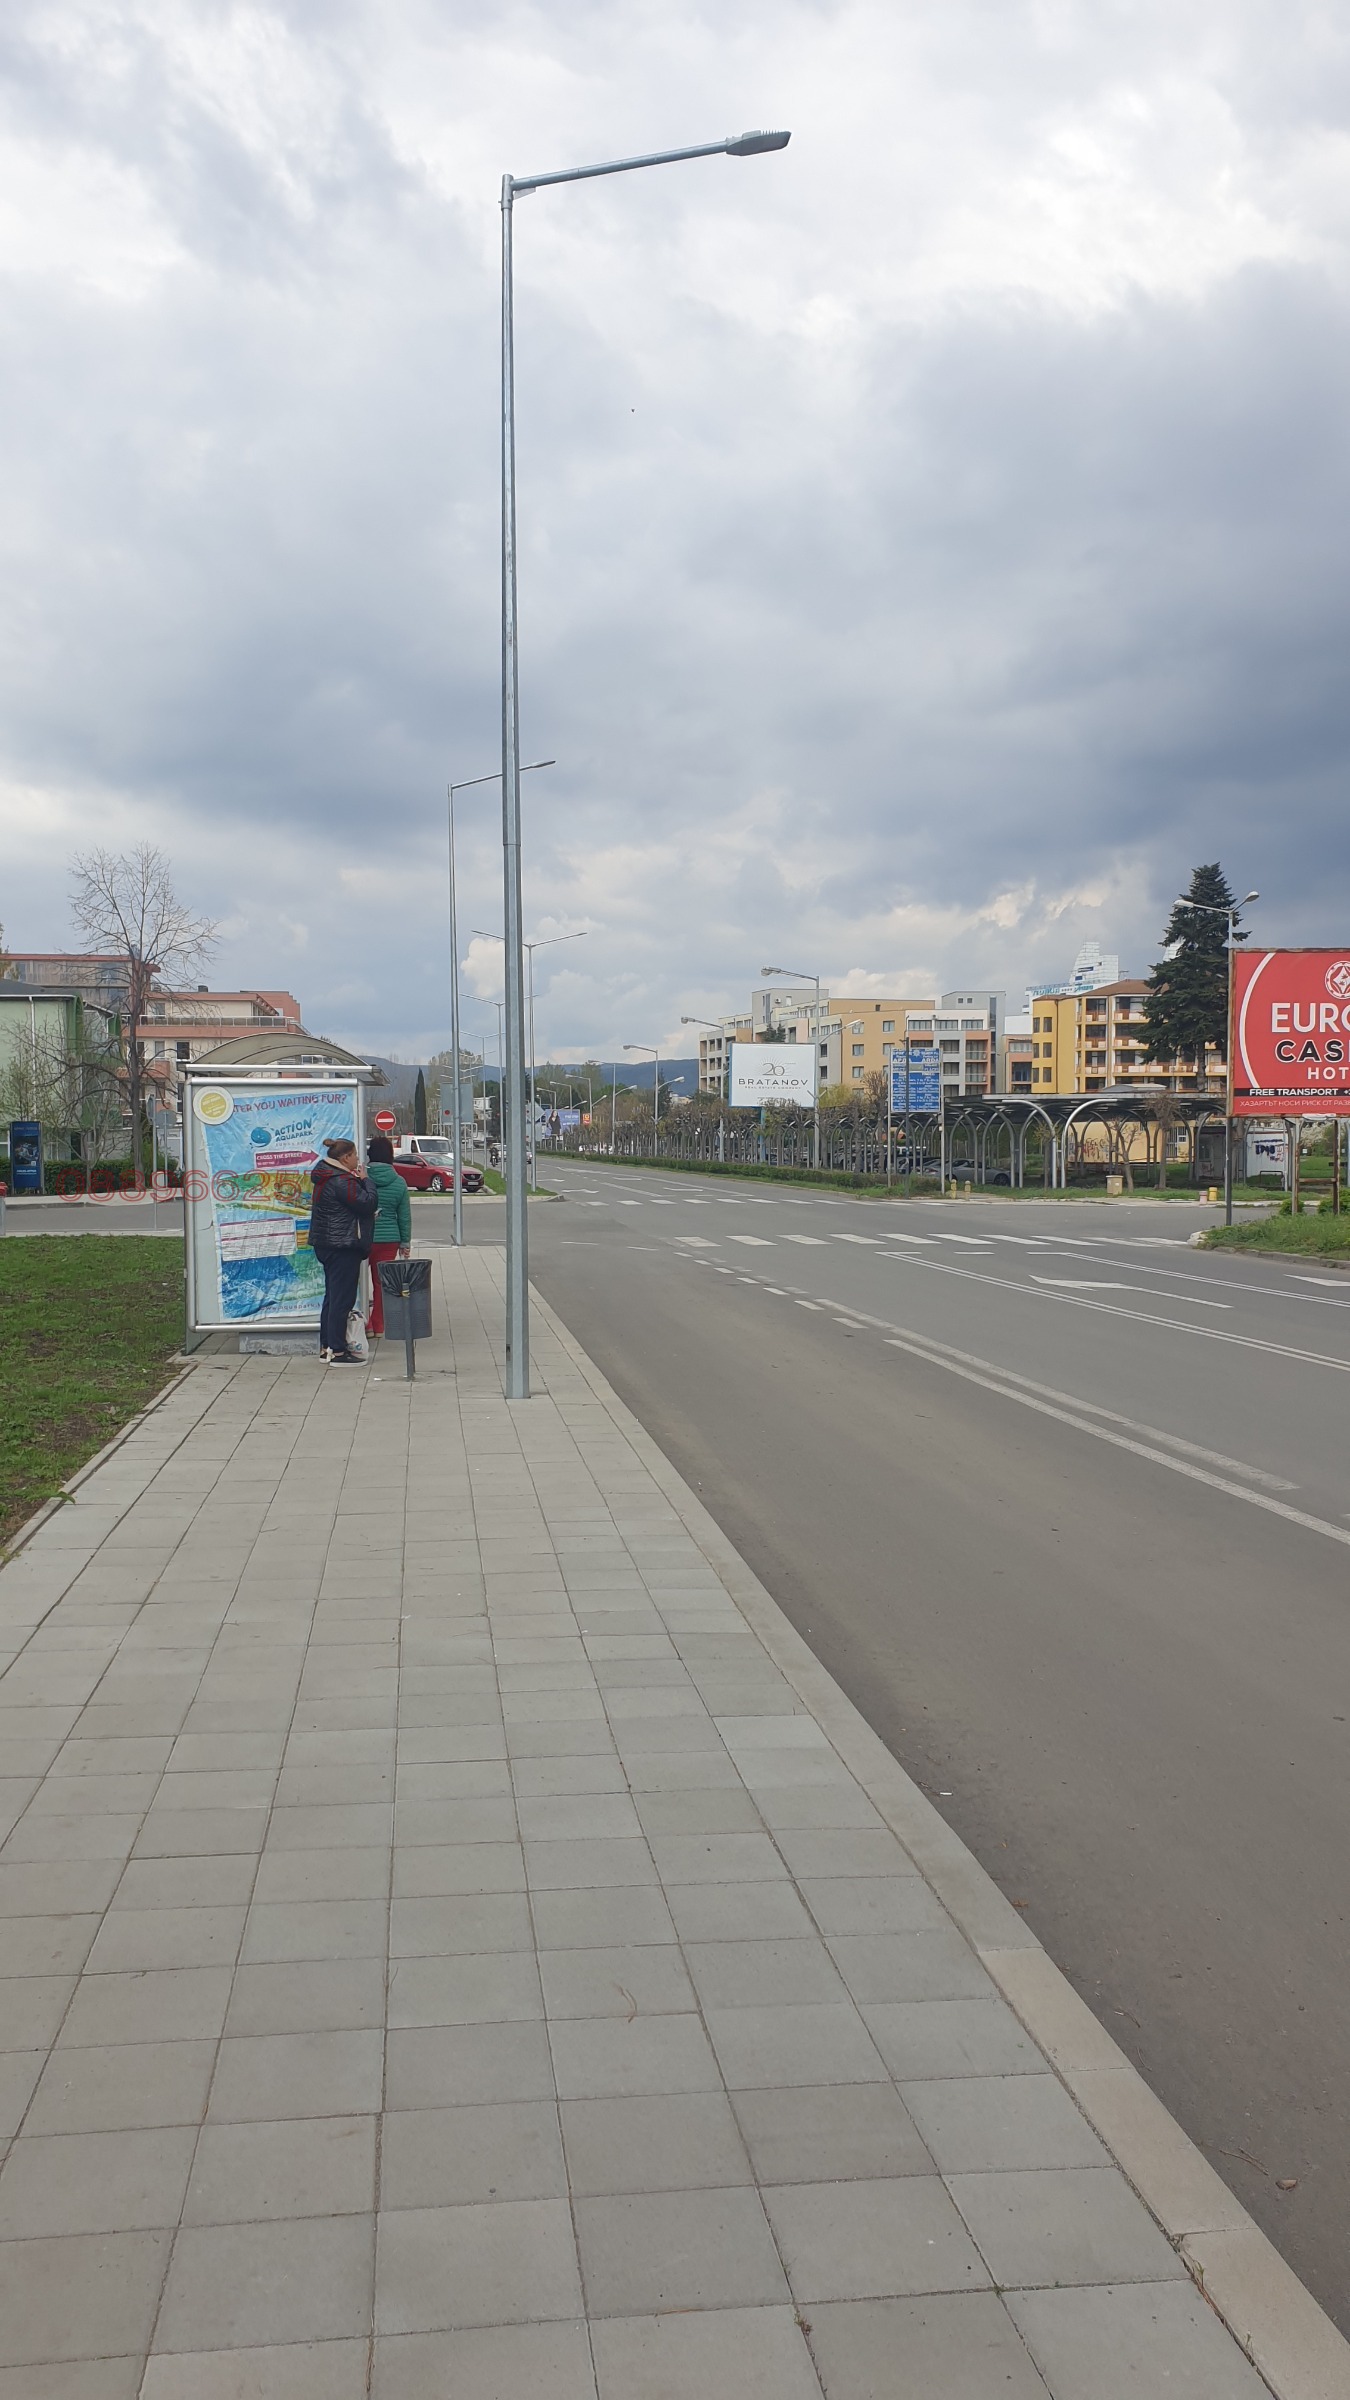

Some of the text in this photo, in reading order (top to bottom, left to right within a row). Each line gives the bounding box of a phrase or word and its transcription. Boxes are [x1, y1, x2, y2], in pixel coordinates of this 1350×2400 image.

[1275, 1039, 1350, 1063] CAS
[762, 1062, 785, 1077] 20
[738, 1078, 808, 1086] BRATANOV
[1249, 1088, 1275, 1096] FREE
[1276, 1088, 1338, 1096] TRANSPORT
[253, 1100, 275, 1111] YOU
[277, 1094, 319, 1107] WAITING
[275, 1117, 312, 1136] ACTION
[276, 1130, 313, 1142] AQUAPARK
